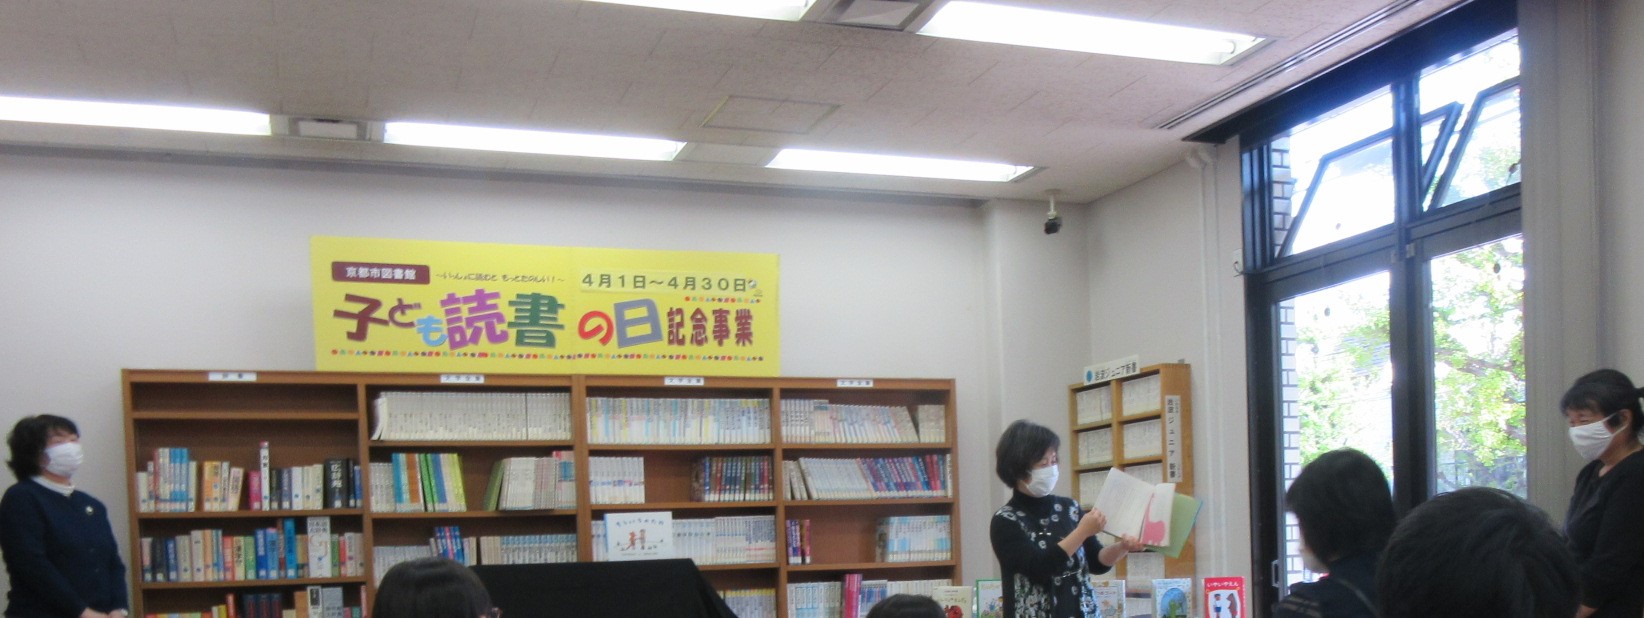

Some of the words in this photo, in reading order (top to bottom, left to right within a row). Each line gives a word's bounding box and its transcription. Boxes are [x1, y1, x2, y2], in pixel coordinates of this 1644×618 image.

[345, 266, 416, 280] 京都市図書館
